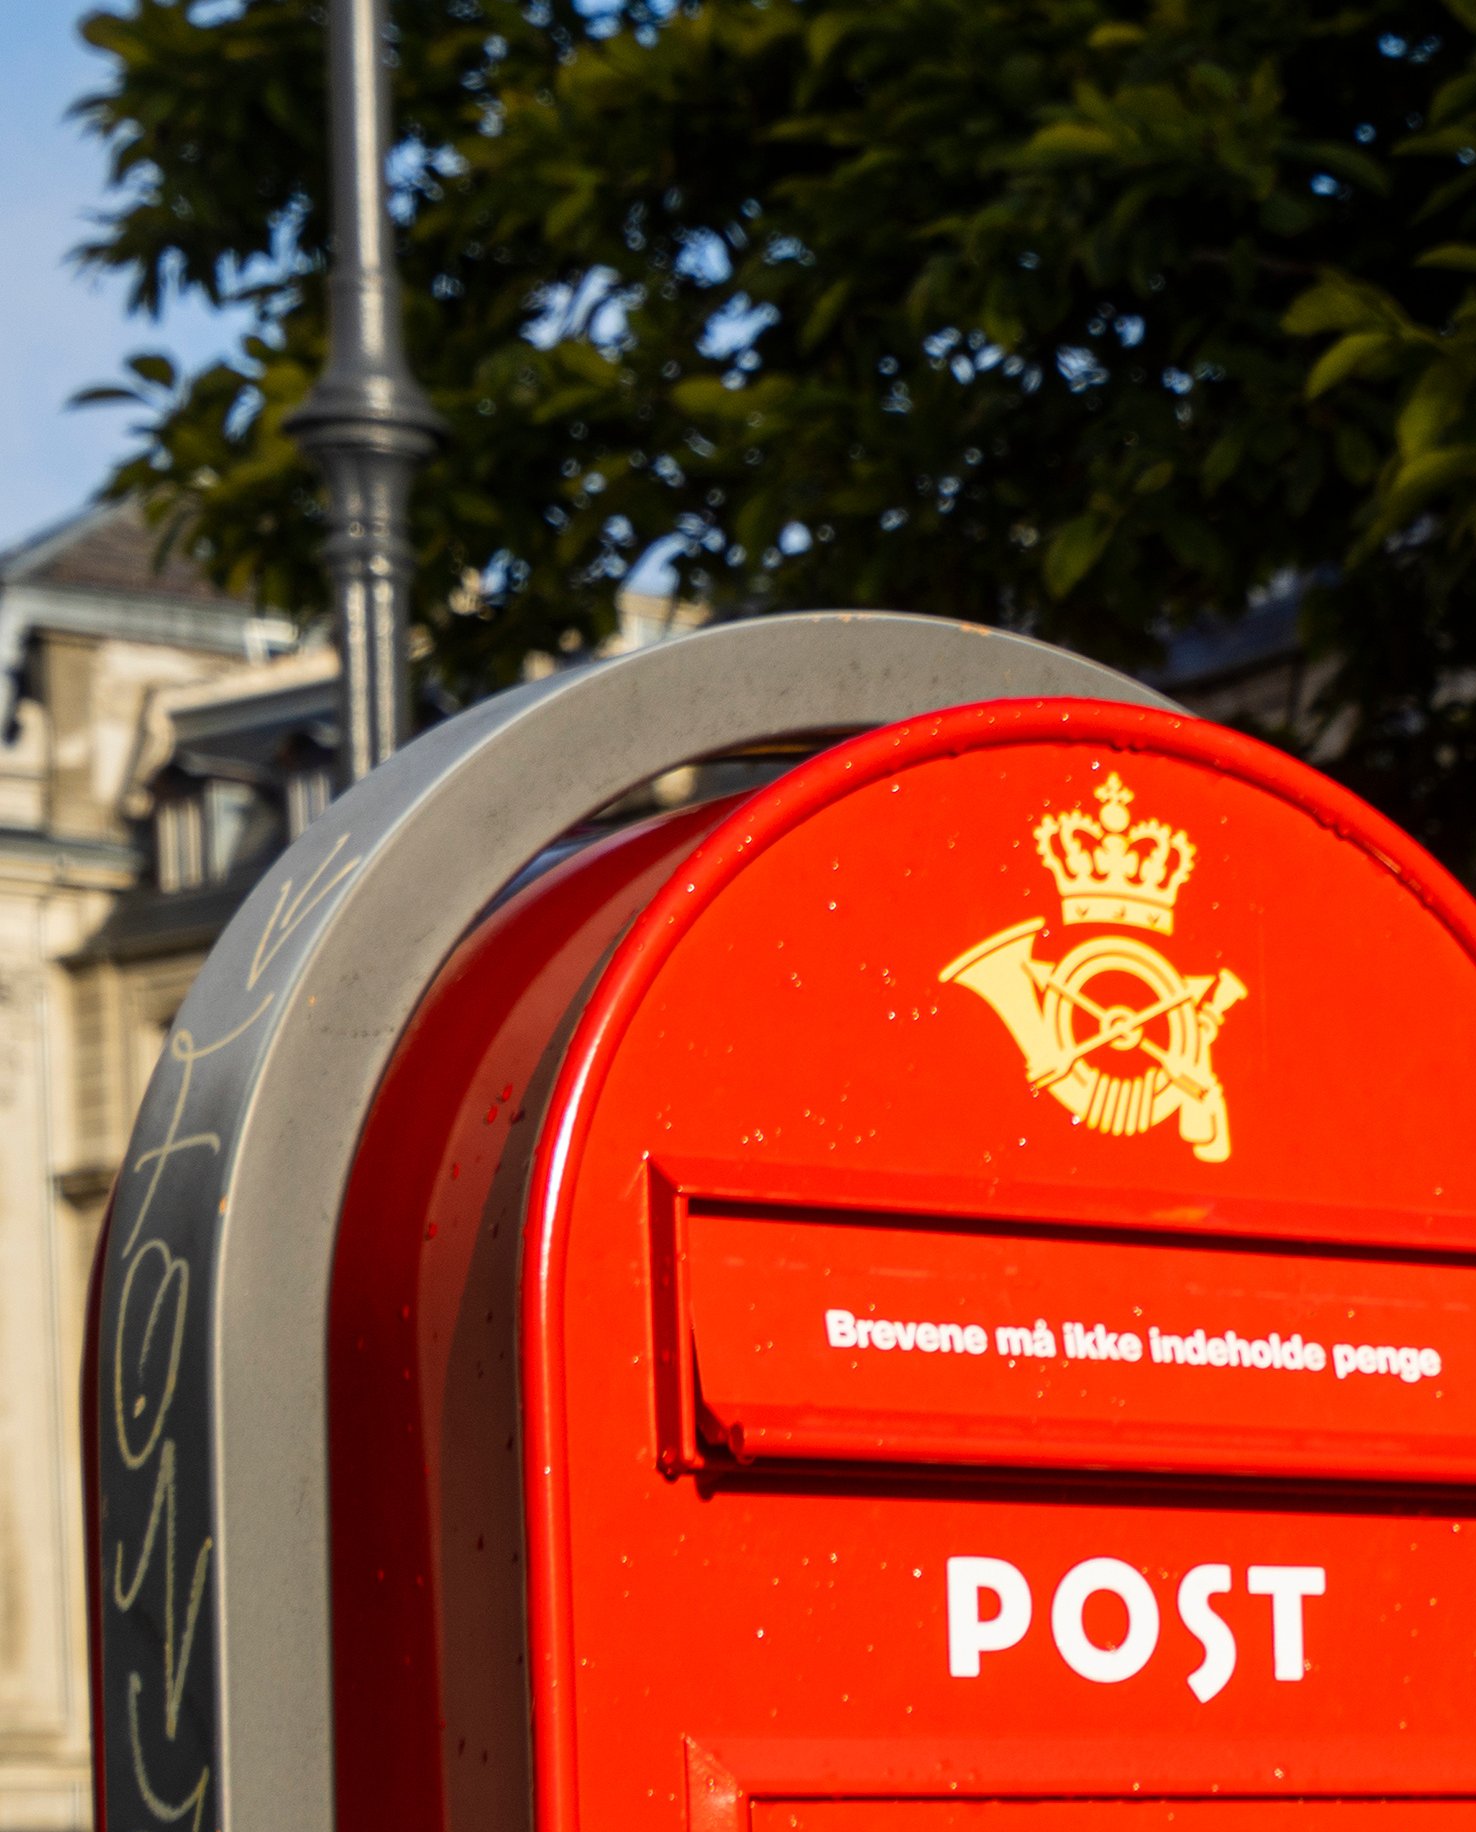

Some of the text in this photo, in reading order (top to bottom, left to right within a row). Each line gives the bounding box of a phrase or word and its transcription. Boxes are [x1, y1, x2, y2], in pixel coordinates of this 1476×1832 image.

[825, 1309, 1442, 1384] Brevene må ikke indeholde penge
[946, 1554, 1327, 1705] POST
